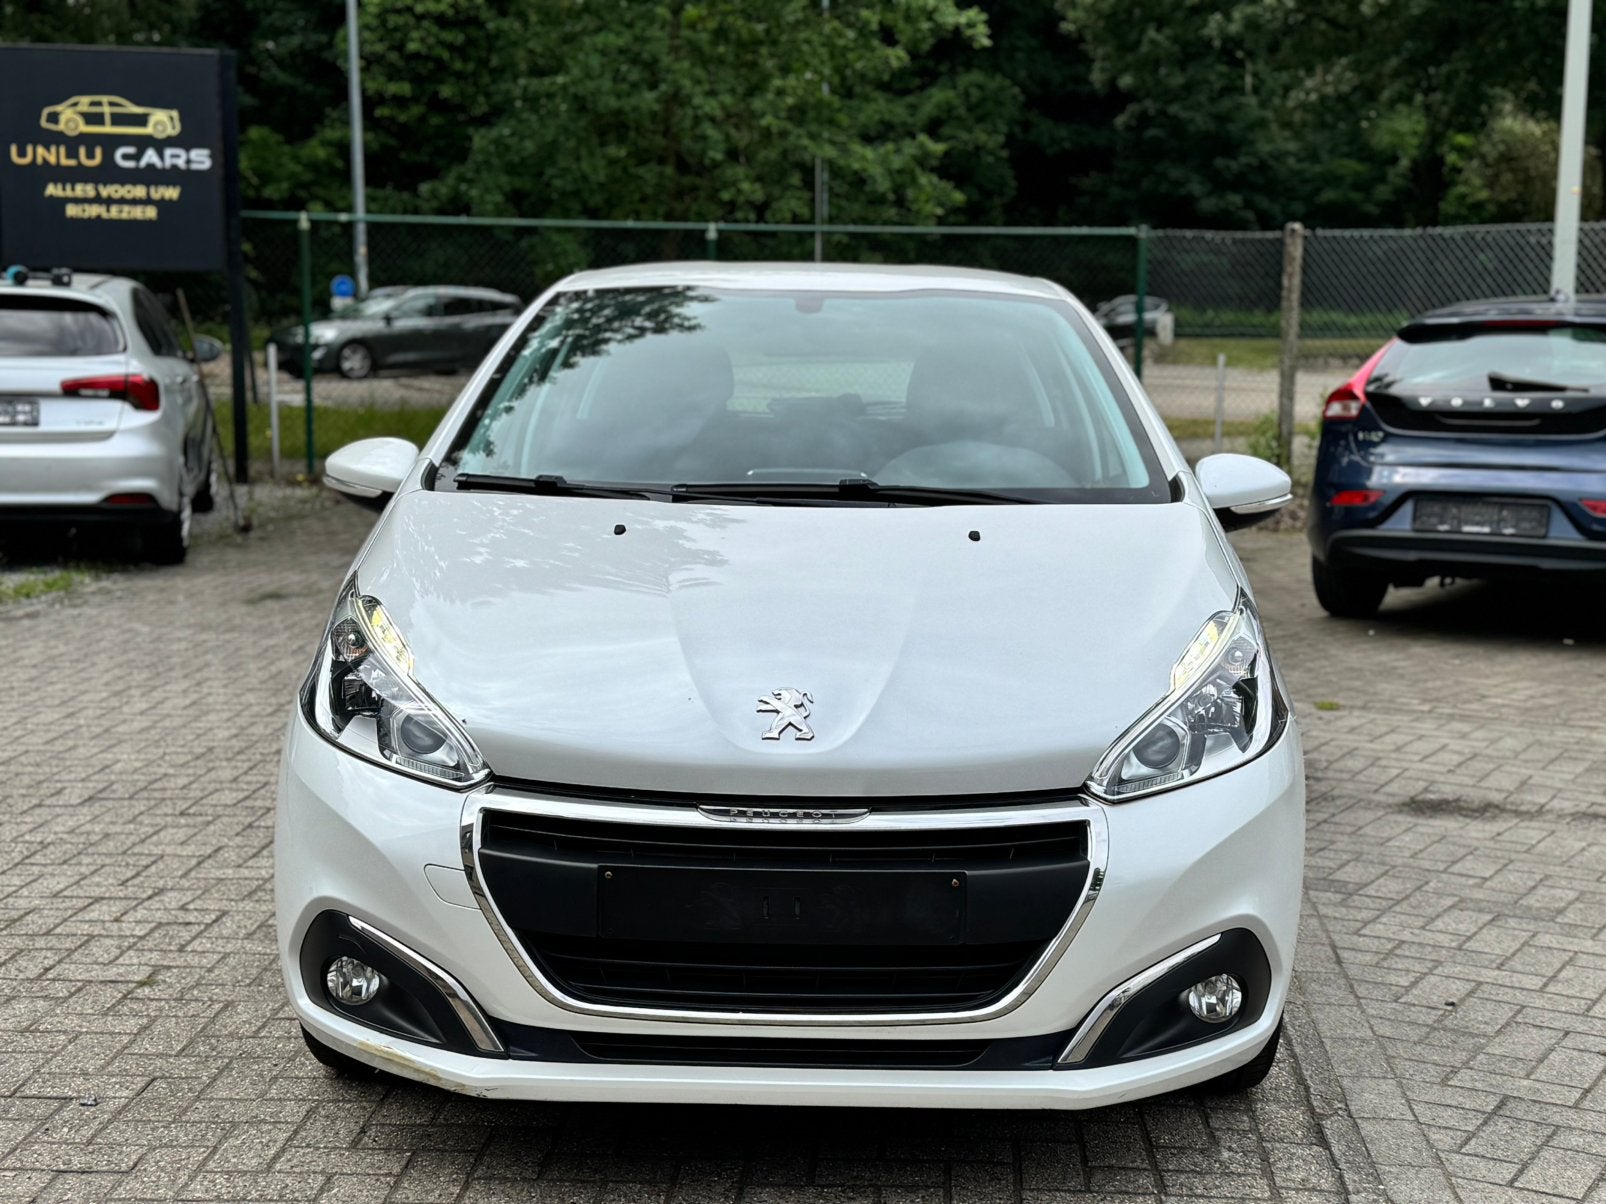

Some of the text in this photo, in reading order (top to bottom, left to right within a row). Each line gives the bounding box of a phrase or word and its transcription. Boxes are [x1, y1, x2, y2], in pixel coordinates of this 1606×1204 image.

[10, 143, 212, 170] UNLU CARS
[44, 183, 181, 201] ALLES VOOR UW
